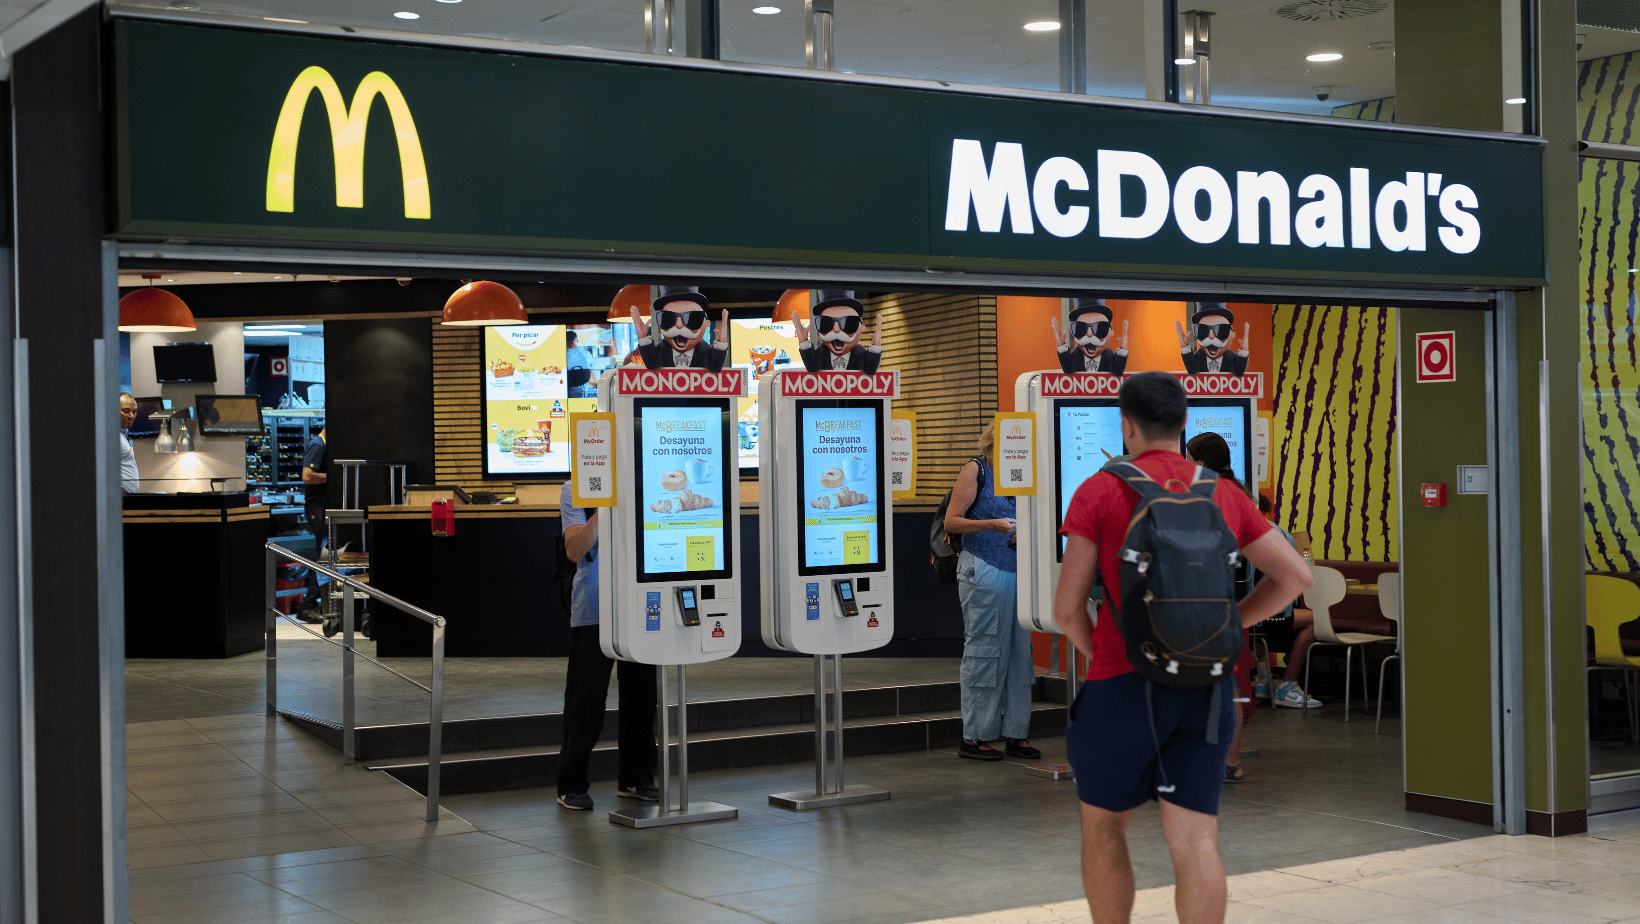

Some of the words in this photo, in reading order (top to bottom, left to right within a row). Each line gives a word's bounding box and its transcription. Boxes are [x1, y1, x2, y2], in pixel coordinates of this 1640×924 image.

[945, 138, 1481, 254] McDonald's
[621, 371, 740, 393] MONOPOLY
[784, 373, 892, 394] MONOPOLY
[656, 420, 706, 433] McBREAKFAST
[816, 420, 862, 432] McBREAKFAST
[660, 436, 705, 447] Desayuna
[819, 435, 861, 446] Desayuna
[652, 448, 670, 456] con
[671, 447, 713, 456] nosotros
[812, 446, 829, 454] con
[830, 445, 868, 453] nosotros
